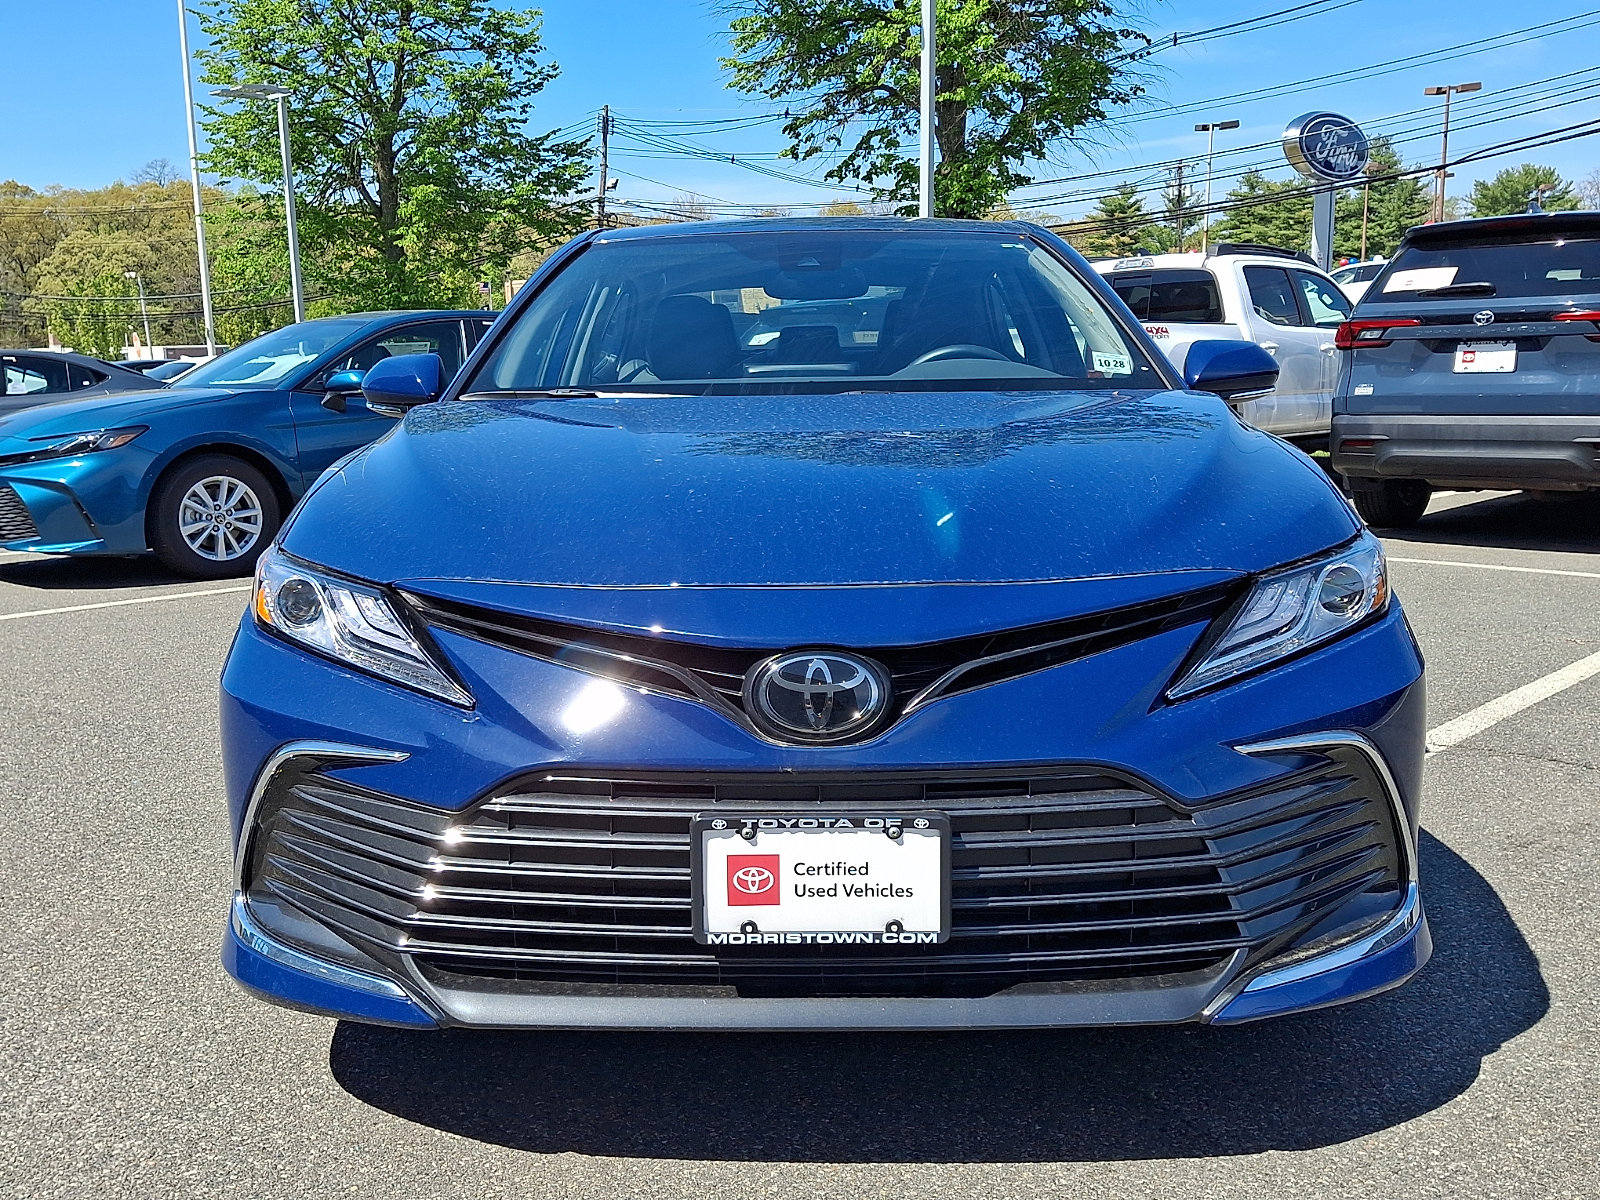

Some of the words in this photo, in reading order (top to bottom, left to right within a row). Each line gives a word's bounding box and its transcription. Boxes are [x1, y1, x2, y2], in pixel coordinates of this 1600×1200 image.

[1316, 124, 1358, 168] Ford
[1098, 359, 1111, 367] 10
[1112, 359, 1125, 368] 28
[740, 818, 854, 828] TOYOTA
[863, 818, 903, 828] OF
[793, 861, 869, 876] Certified
[793, 883, 838, 898] Used
[843, 883, 914, 898] Vehicles
[707, 932, 937, 944] MORRISTOWN.COM
